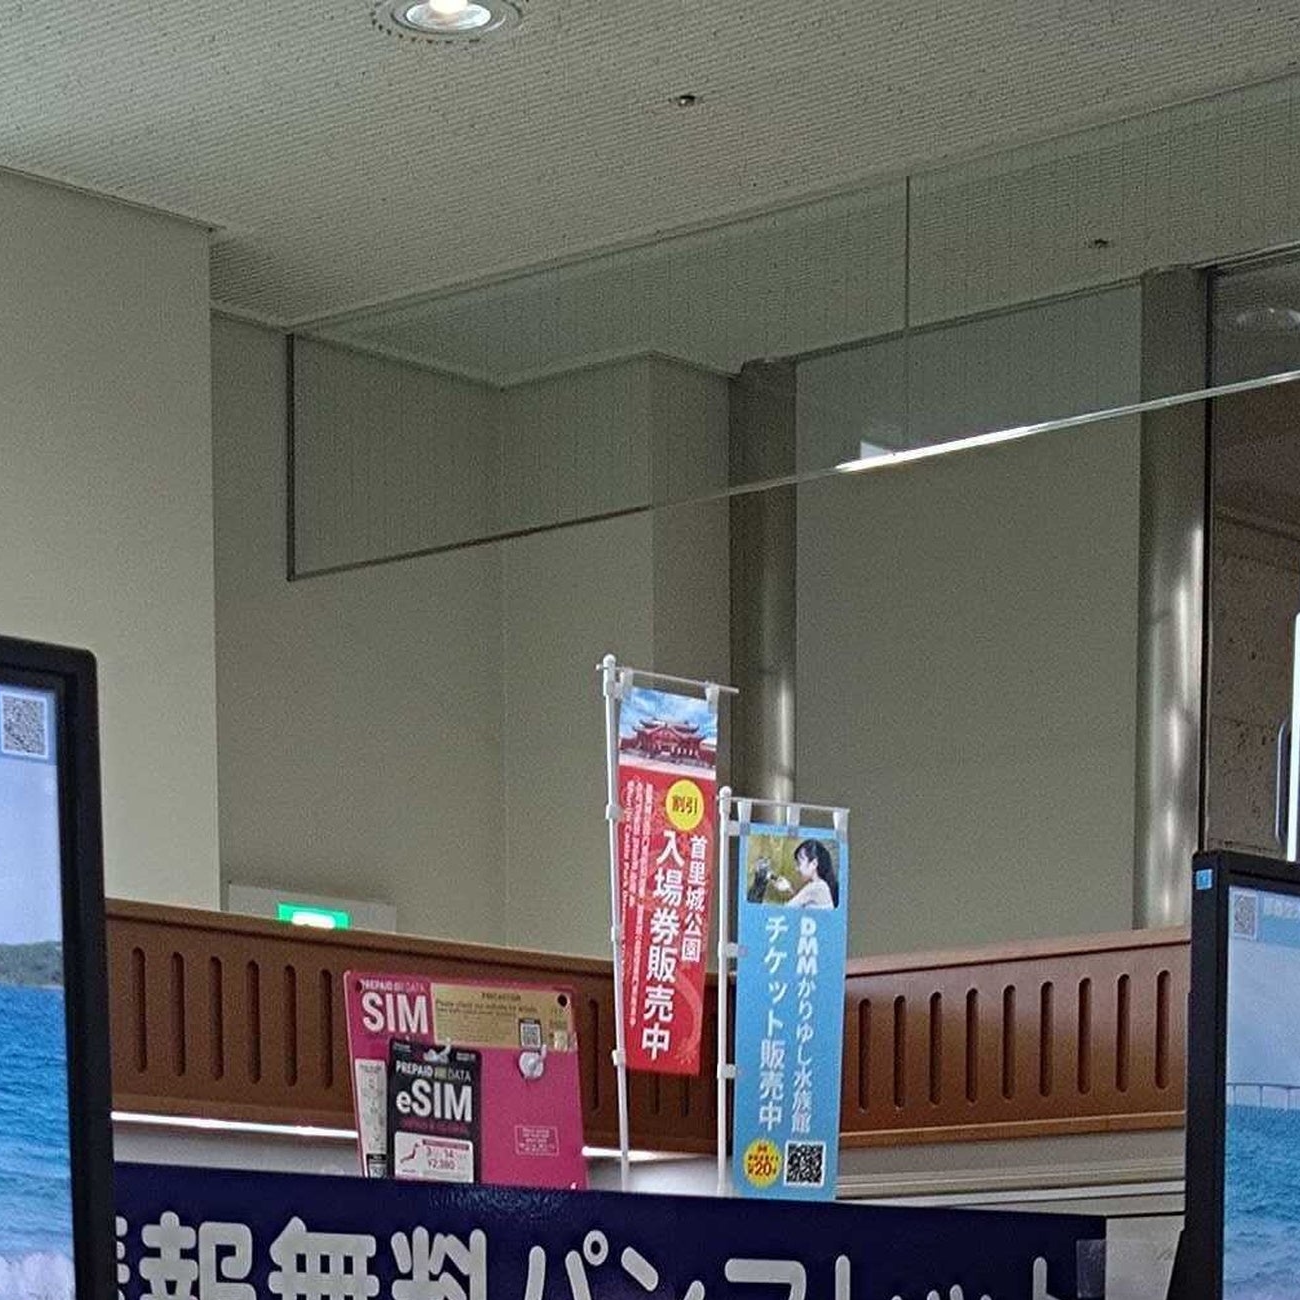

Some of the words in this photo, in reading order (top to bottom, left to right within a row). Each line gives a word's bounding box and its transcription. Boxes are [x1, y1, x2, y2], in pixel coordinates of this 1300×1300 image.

[672, 795, 697, 816] 割引
[681, 834, 707, 963] 首里城公園
[641, 829, 685, 1061] 入場券販売中
[362, 992, 428, 1035] SIM
[759, 915, 788, 1132] チケット販売中
[791, 916, 818, 1134] DMMかりゆし水族館
[396, 1060, 433, 1078] PREPAID
[396, 1079, 472, 1122] eSIM
